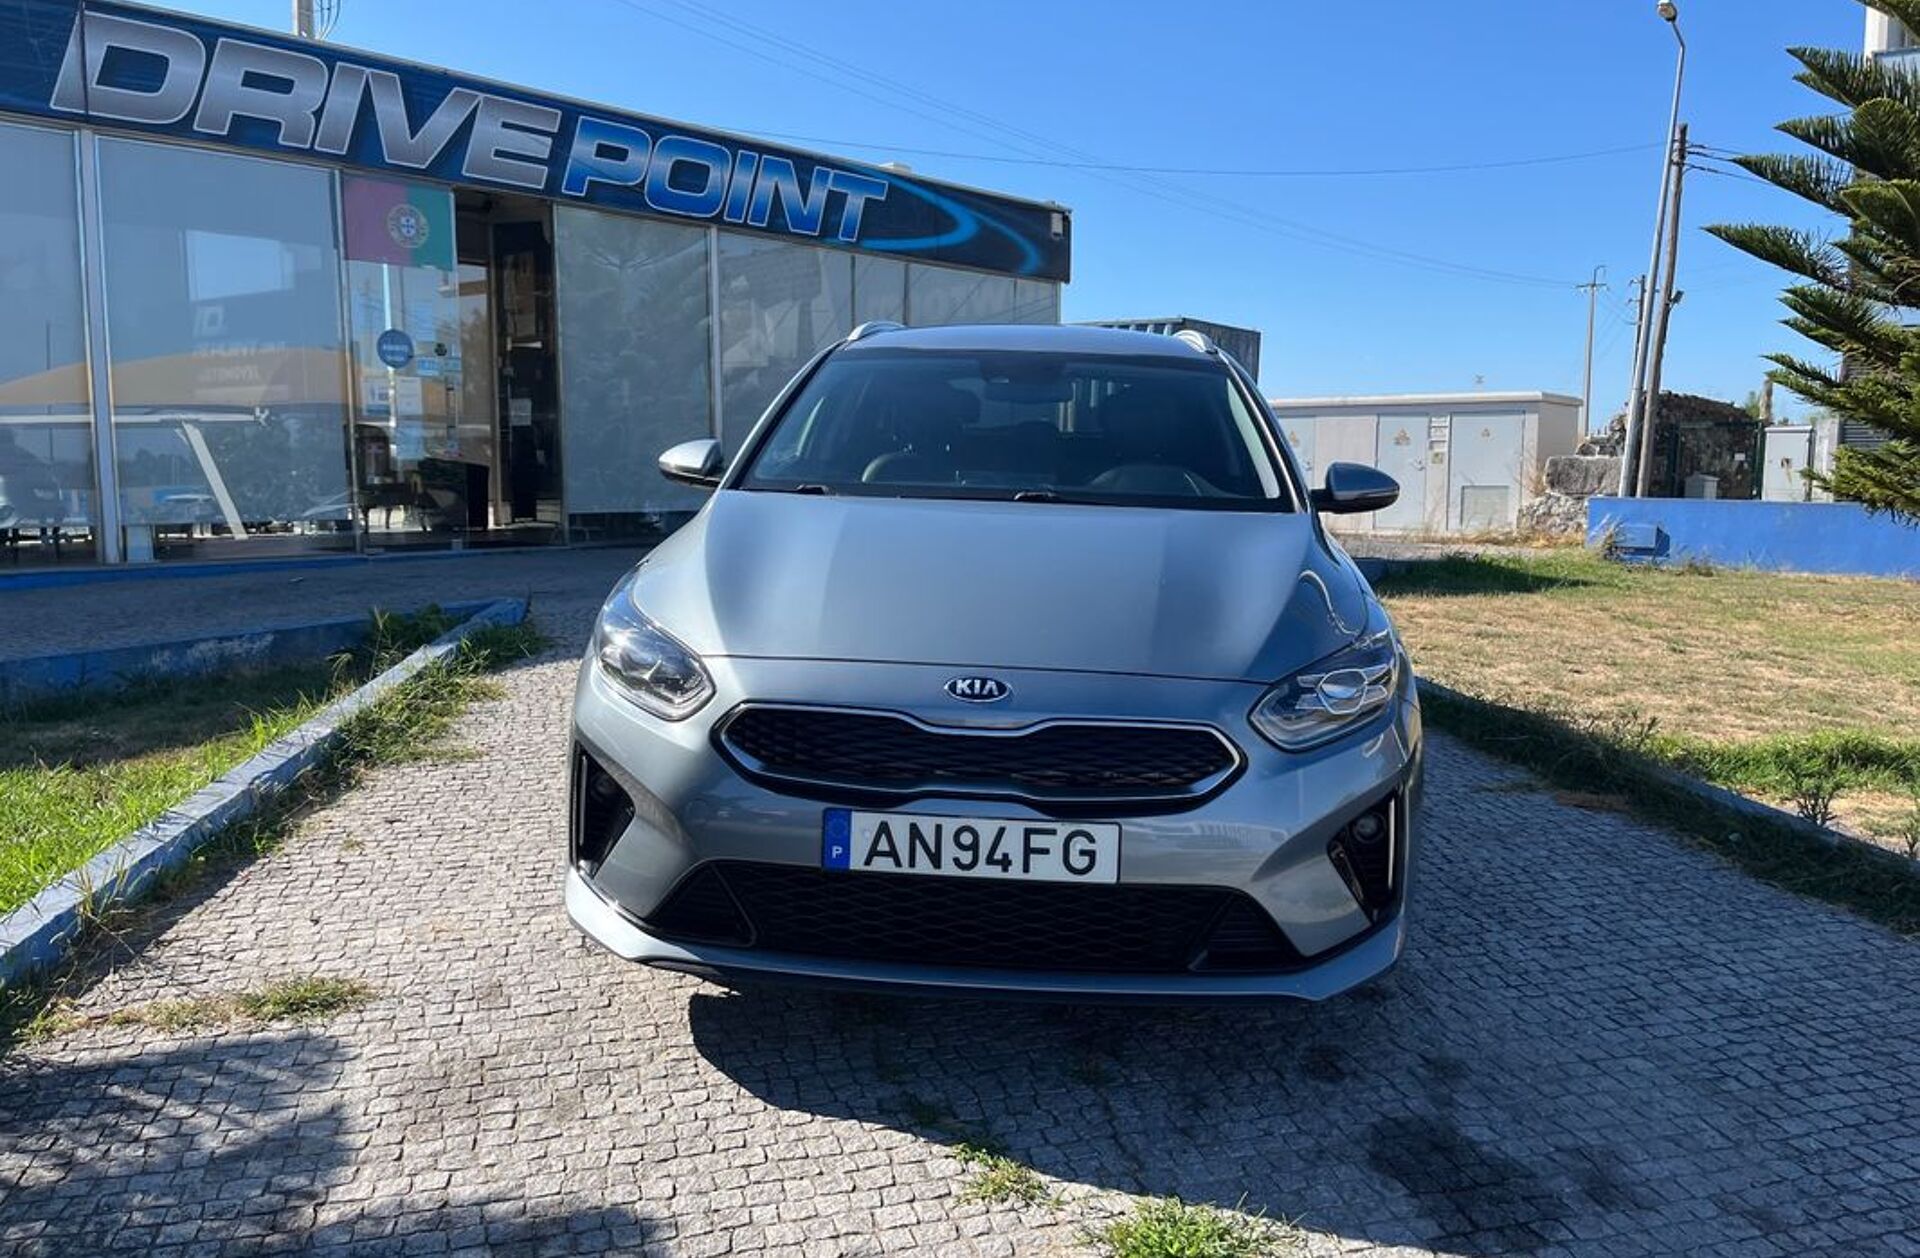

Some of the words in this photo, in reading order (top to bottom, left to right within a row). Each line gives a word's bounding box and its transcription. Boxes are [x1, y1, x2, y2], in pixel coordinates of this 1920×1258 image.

[955, 678, 999, 695] KIA
[831, 845, 843, 859] P
[863, 820, 1097, 876] AN94FG
